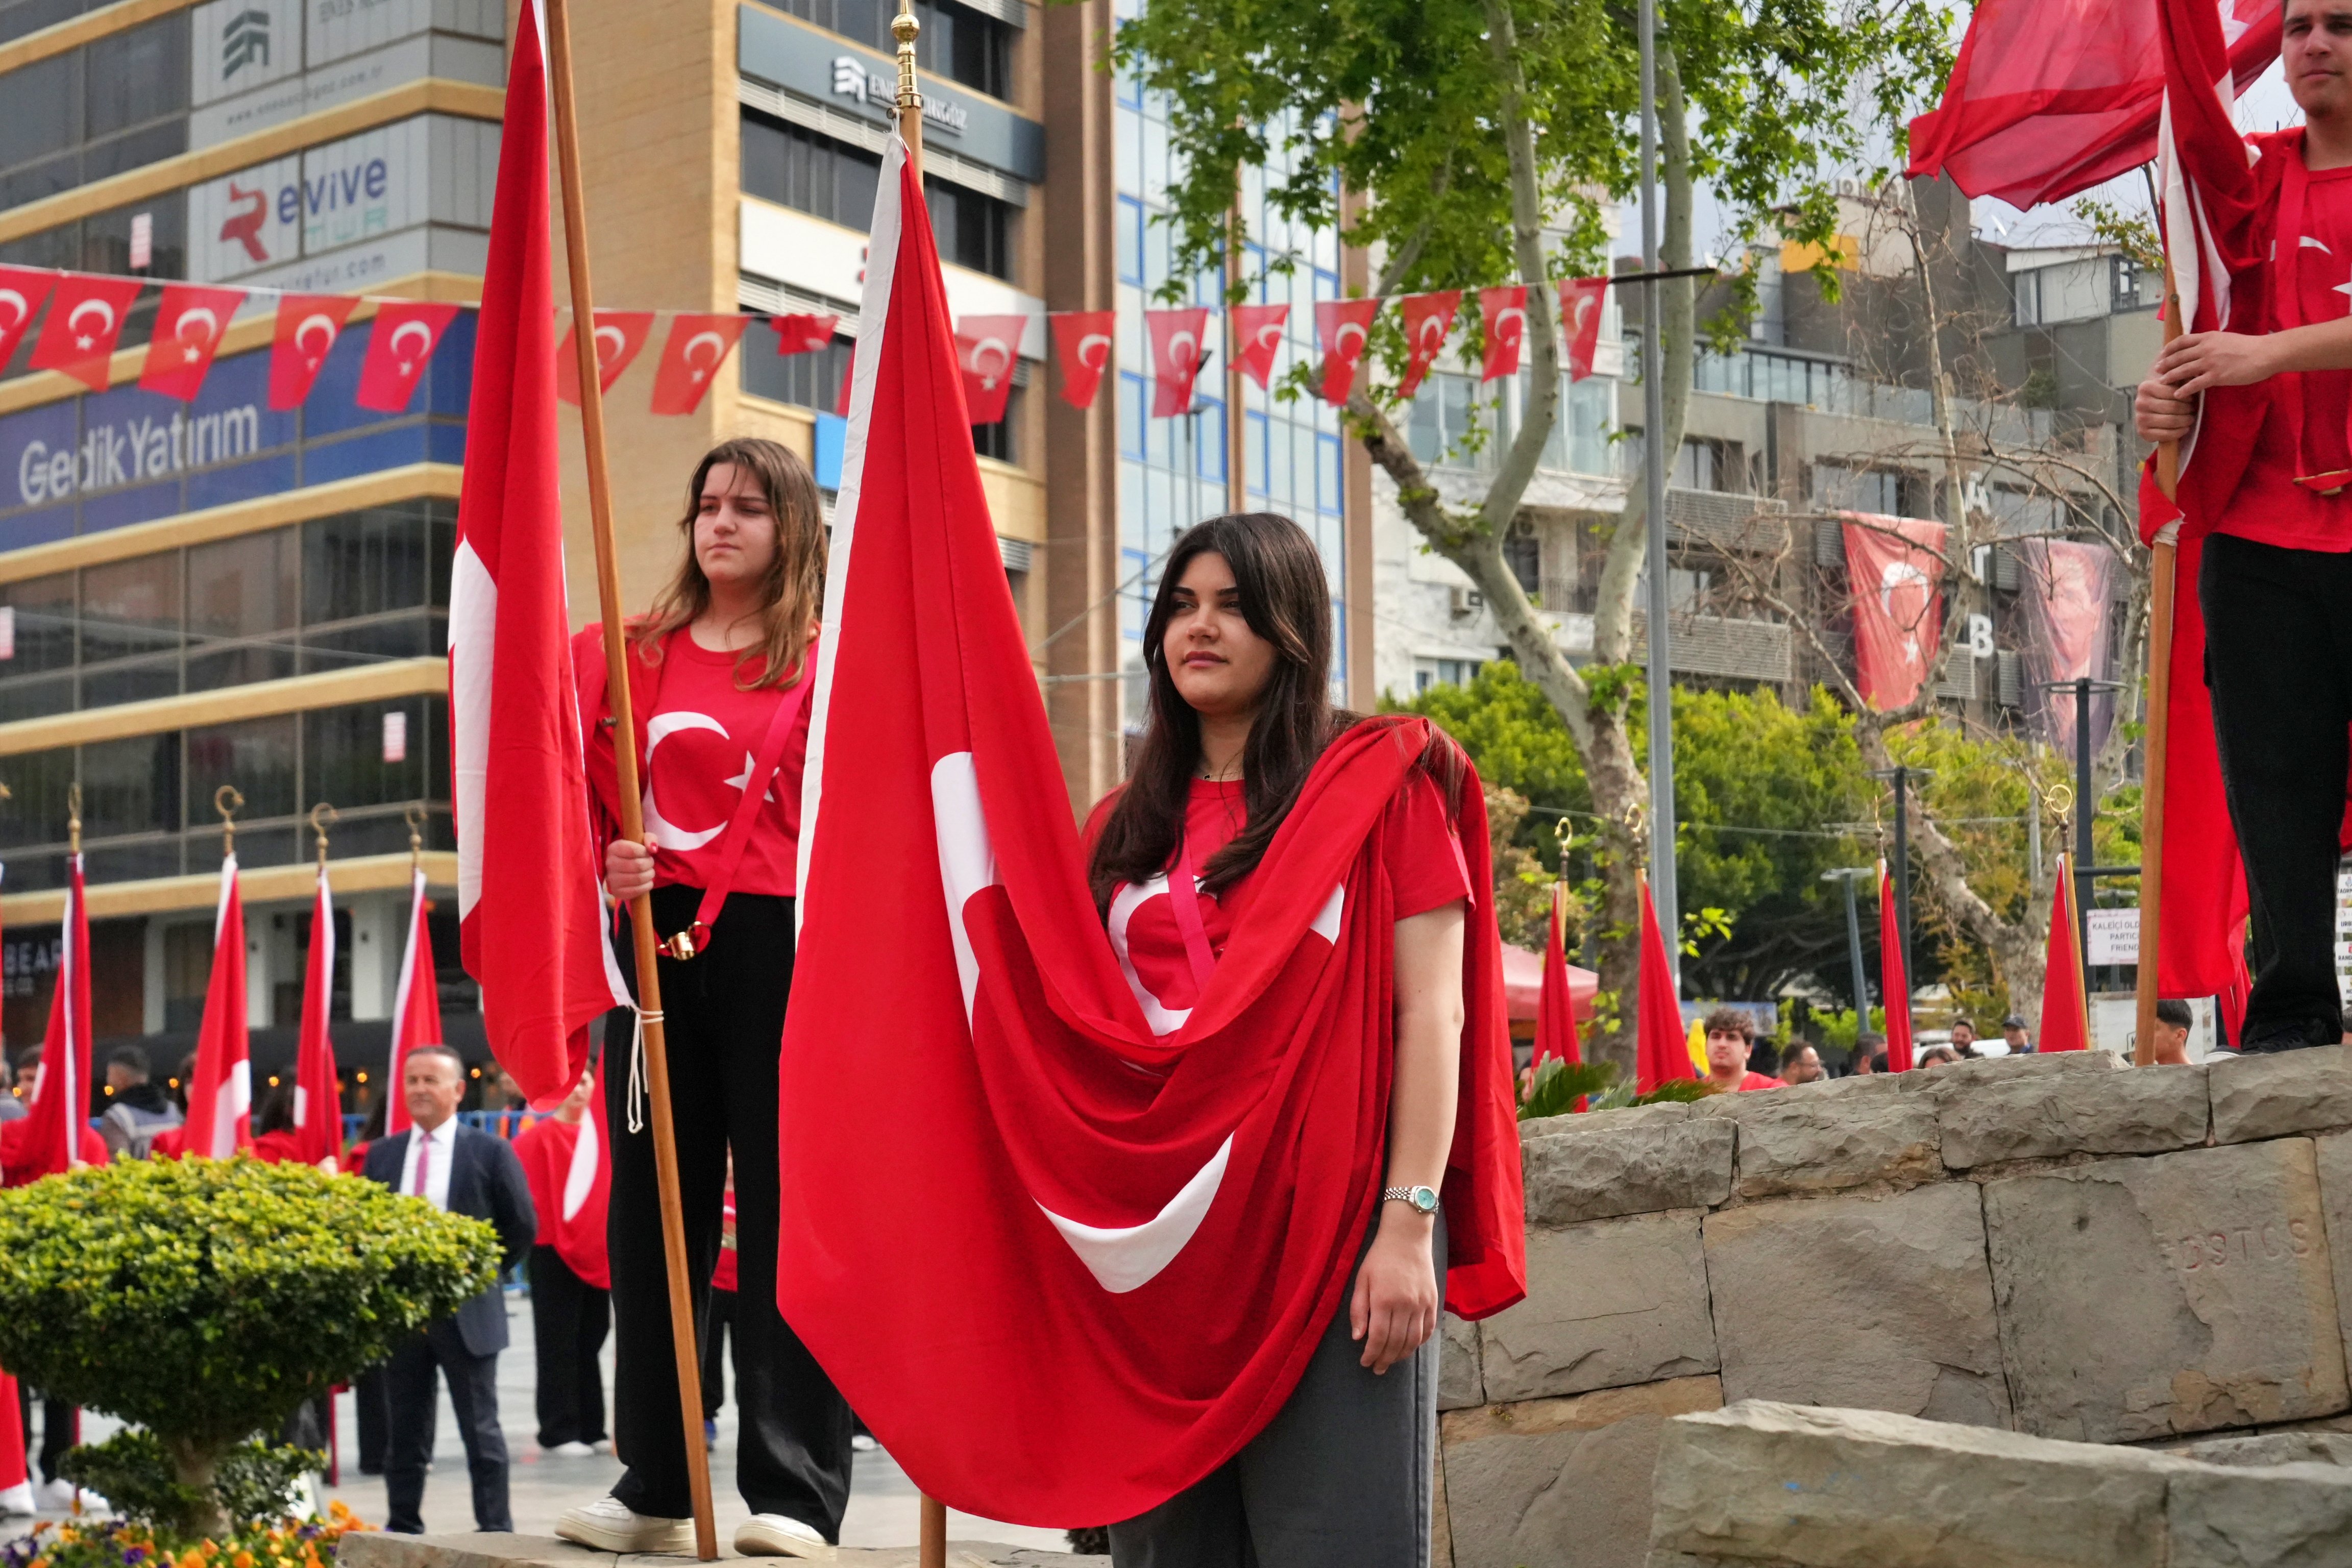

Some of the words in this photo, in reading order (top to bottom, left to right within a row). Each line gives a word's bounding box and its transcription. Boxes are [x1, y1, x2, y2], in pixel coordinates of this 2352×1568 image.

[19, 425, 126, 504] Gedik
[128, 404, 257, 480] Yatırım
[2110, 933, 2139, 941] PARTIC
[2111, 943, 2140, 952] FRIEND
